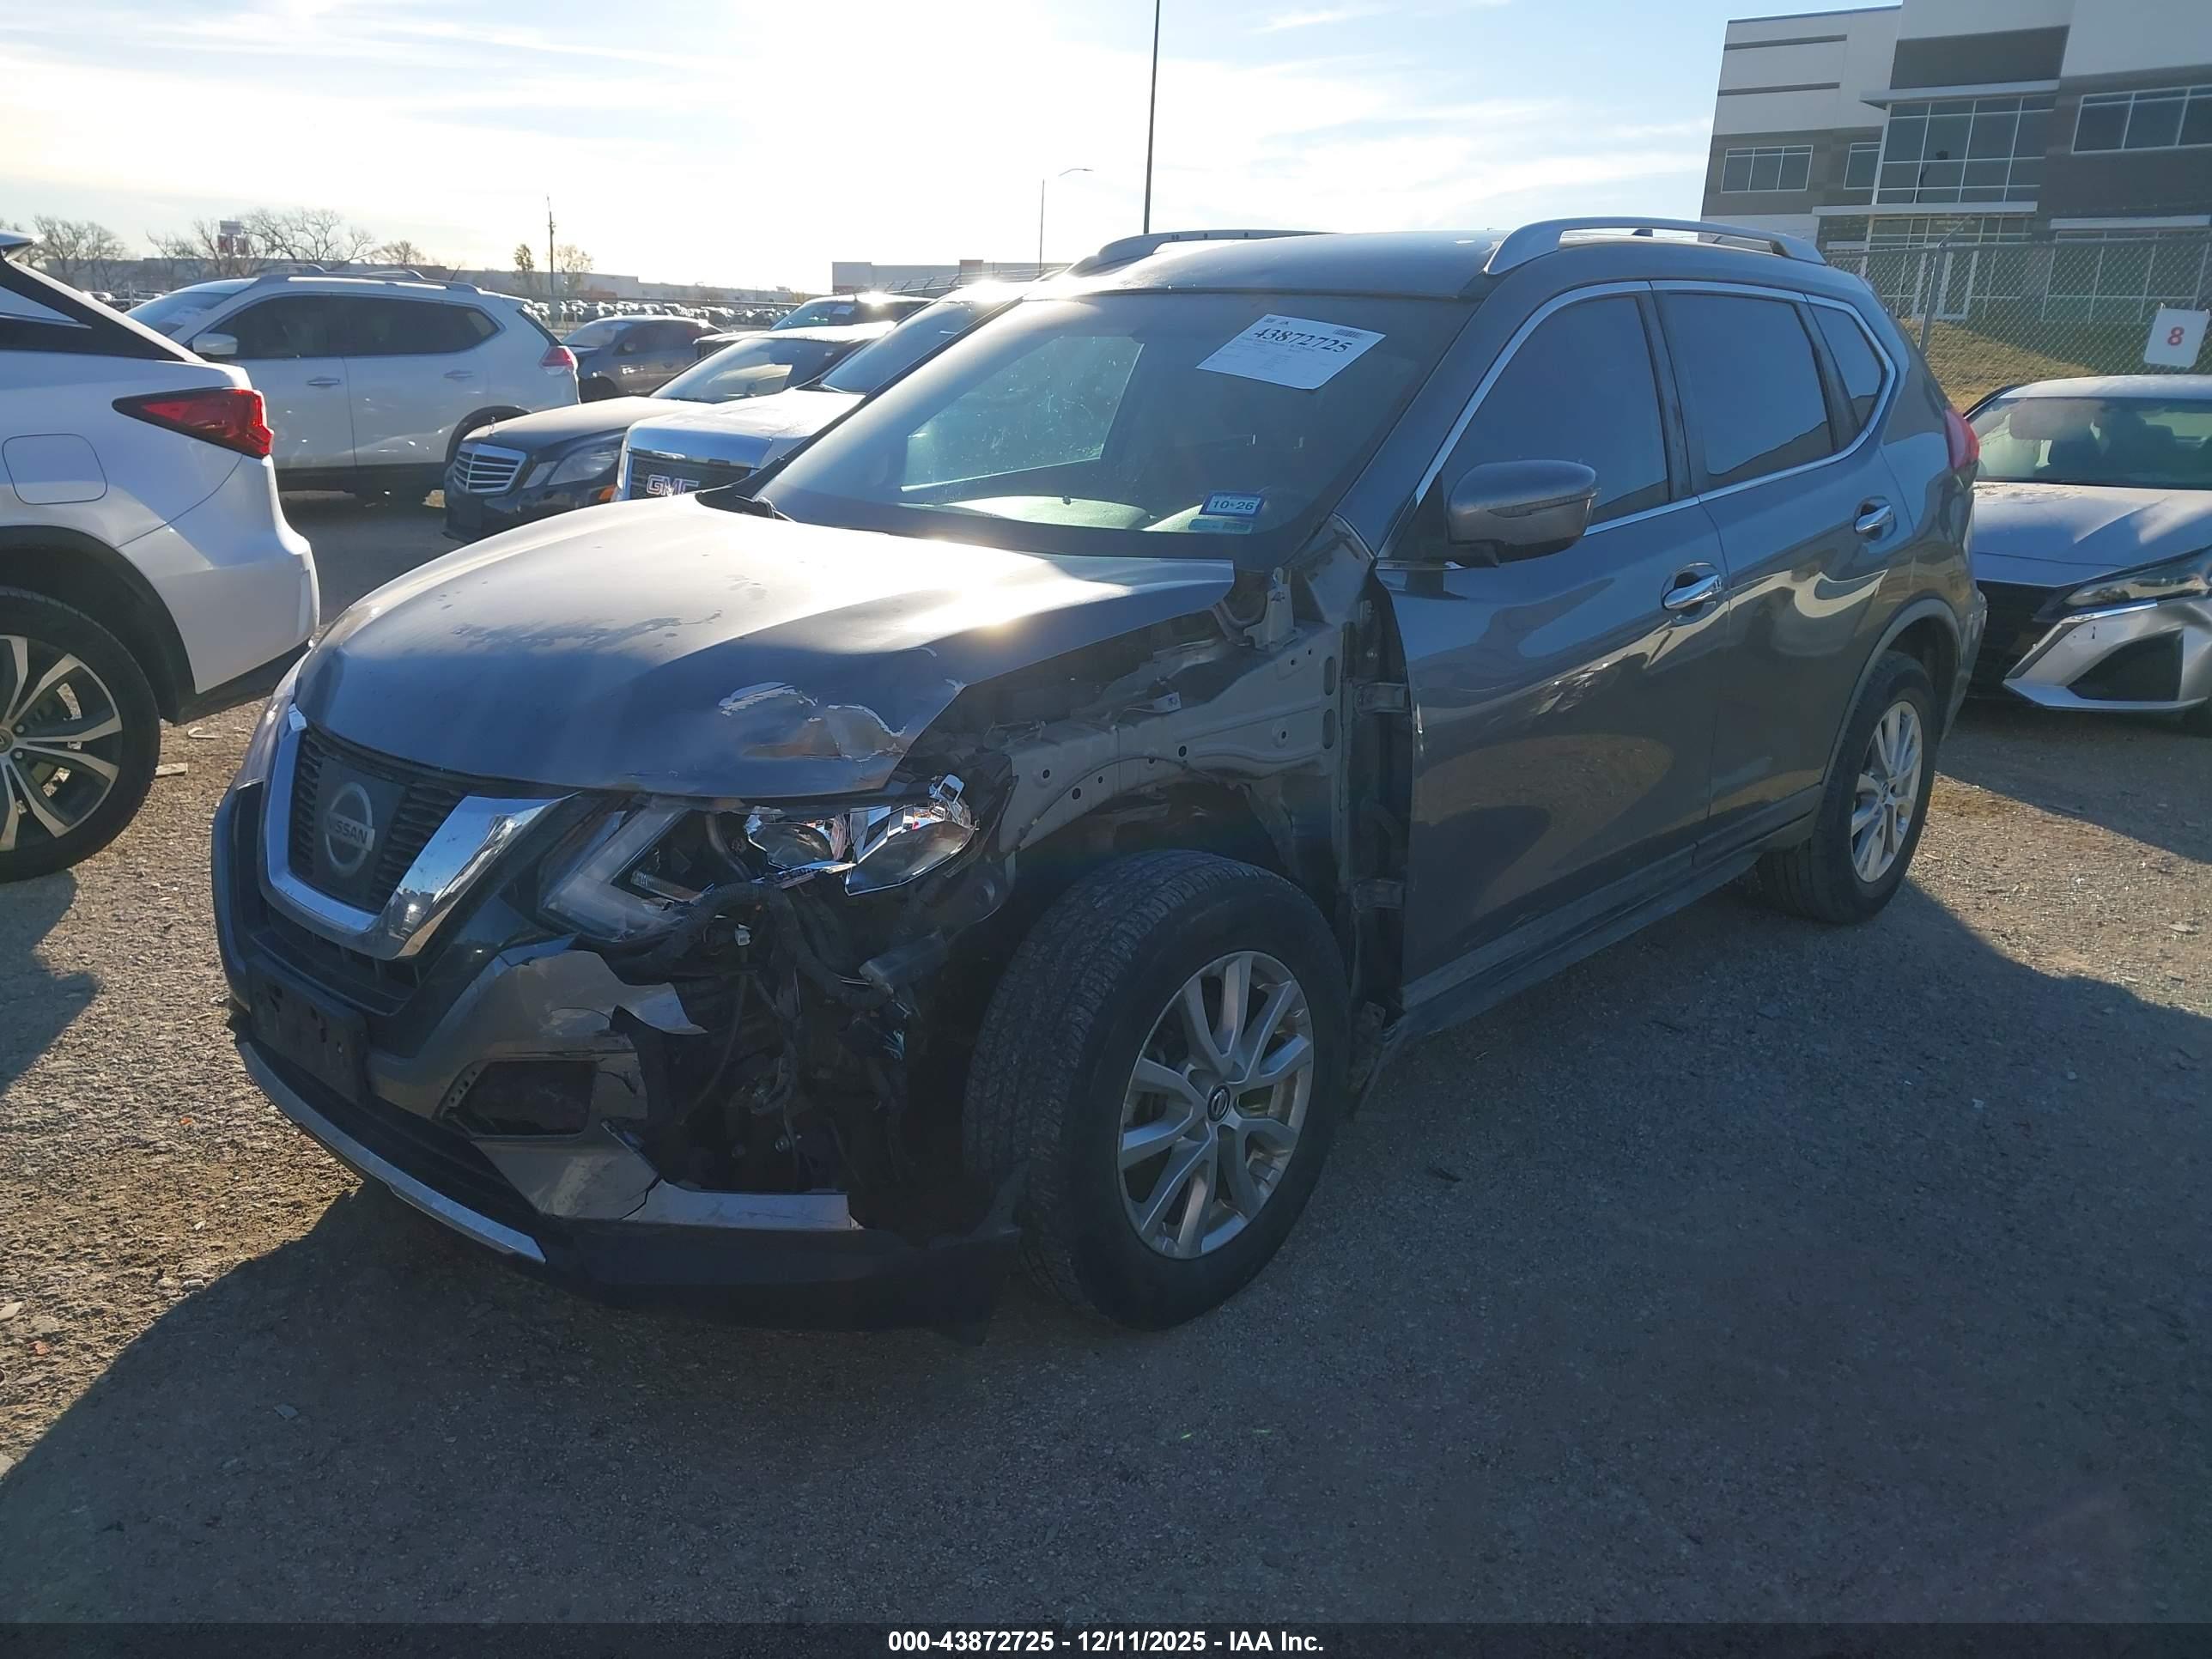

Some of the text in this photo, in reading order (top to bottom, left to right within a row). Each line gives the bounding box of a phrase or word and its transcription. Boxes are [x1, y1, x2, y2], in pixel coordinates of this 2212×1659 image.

[1254, 328, 1353, 353] 43872725
[2167, 326, 2185, 346] 8
[328, 816, 368, 844] SSAN
